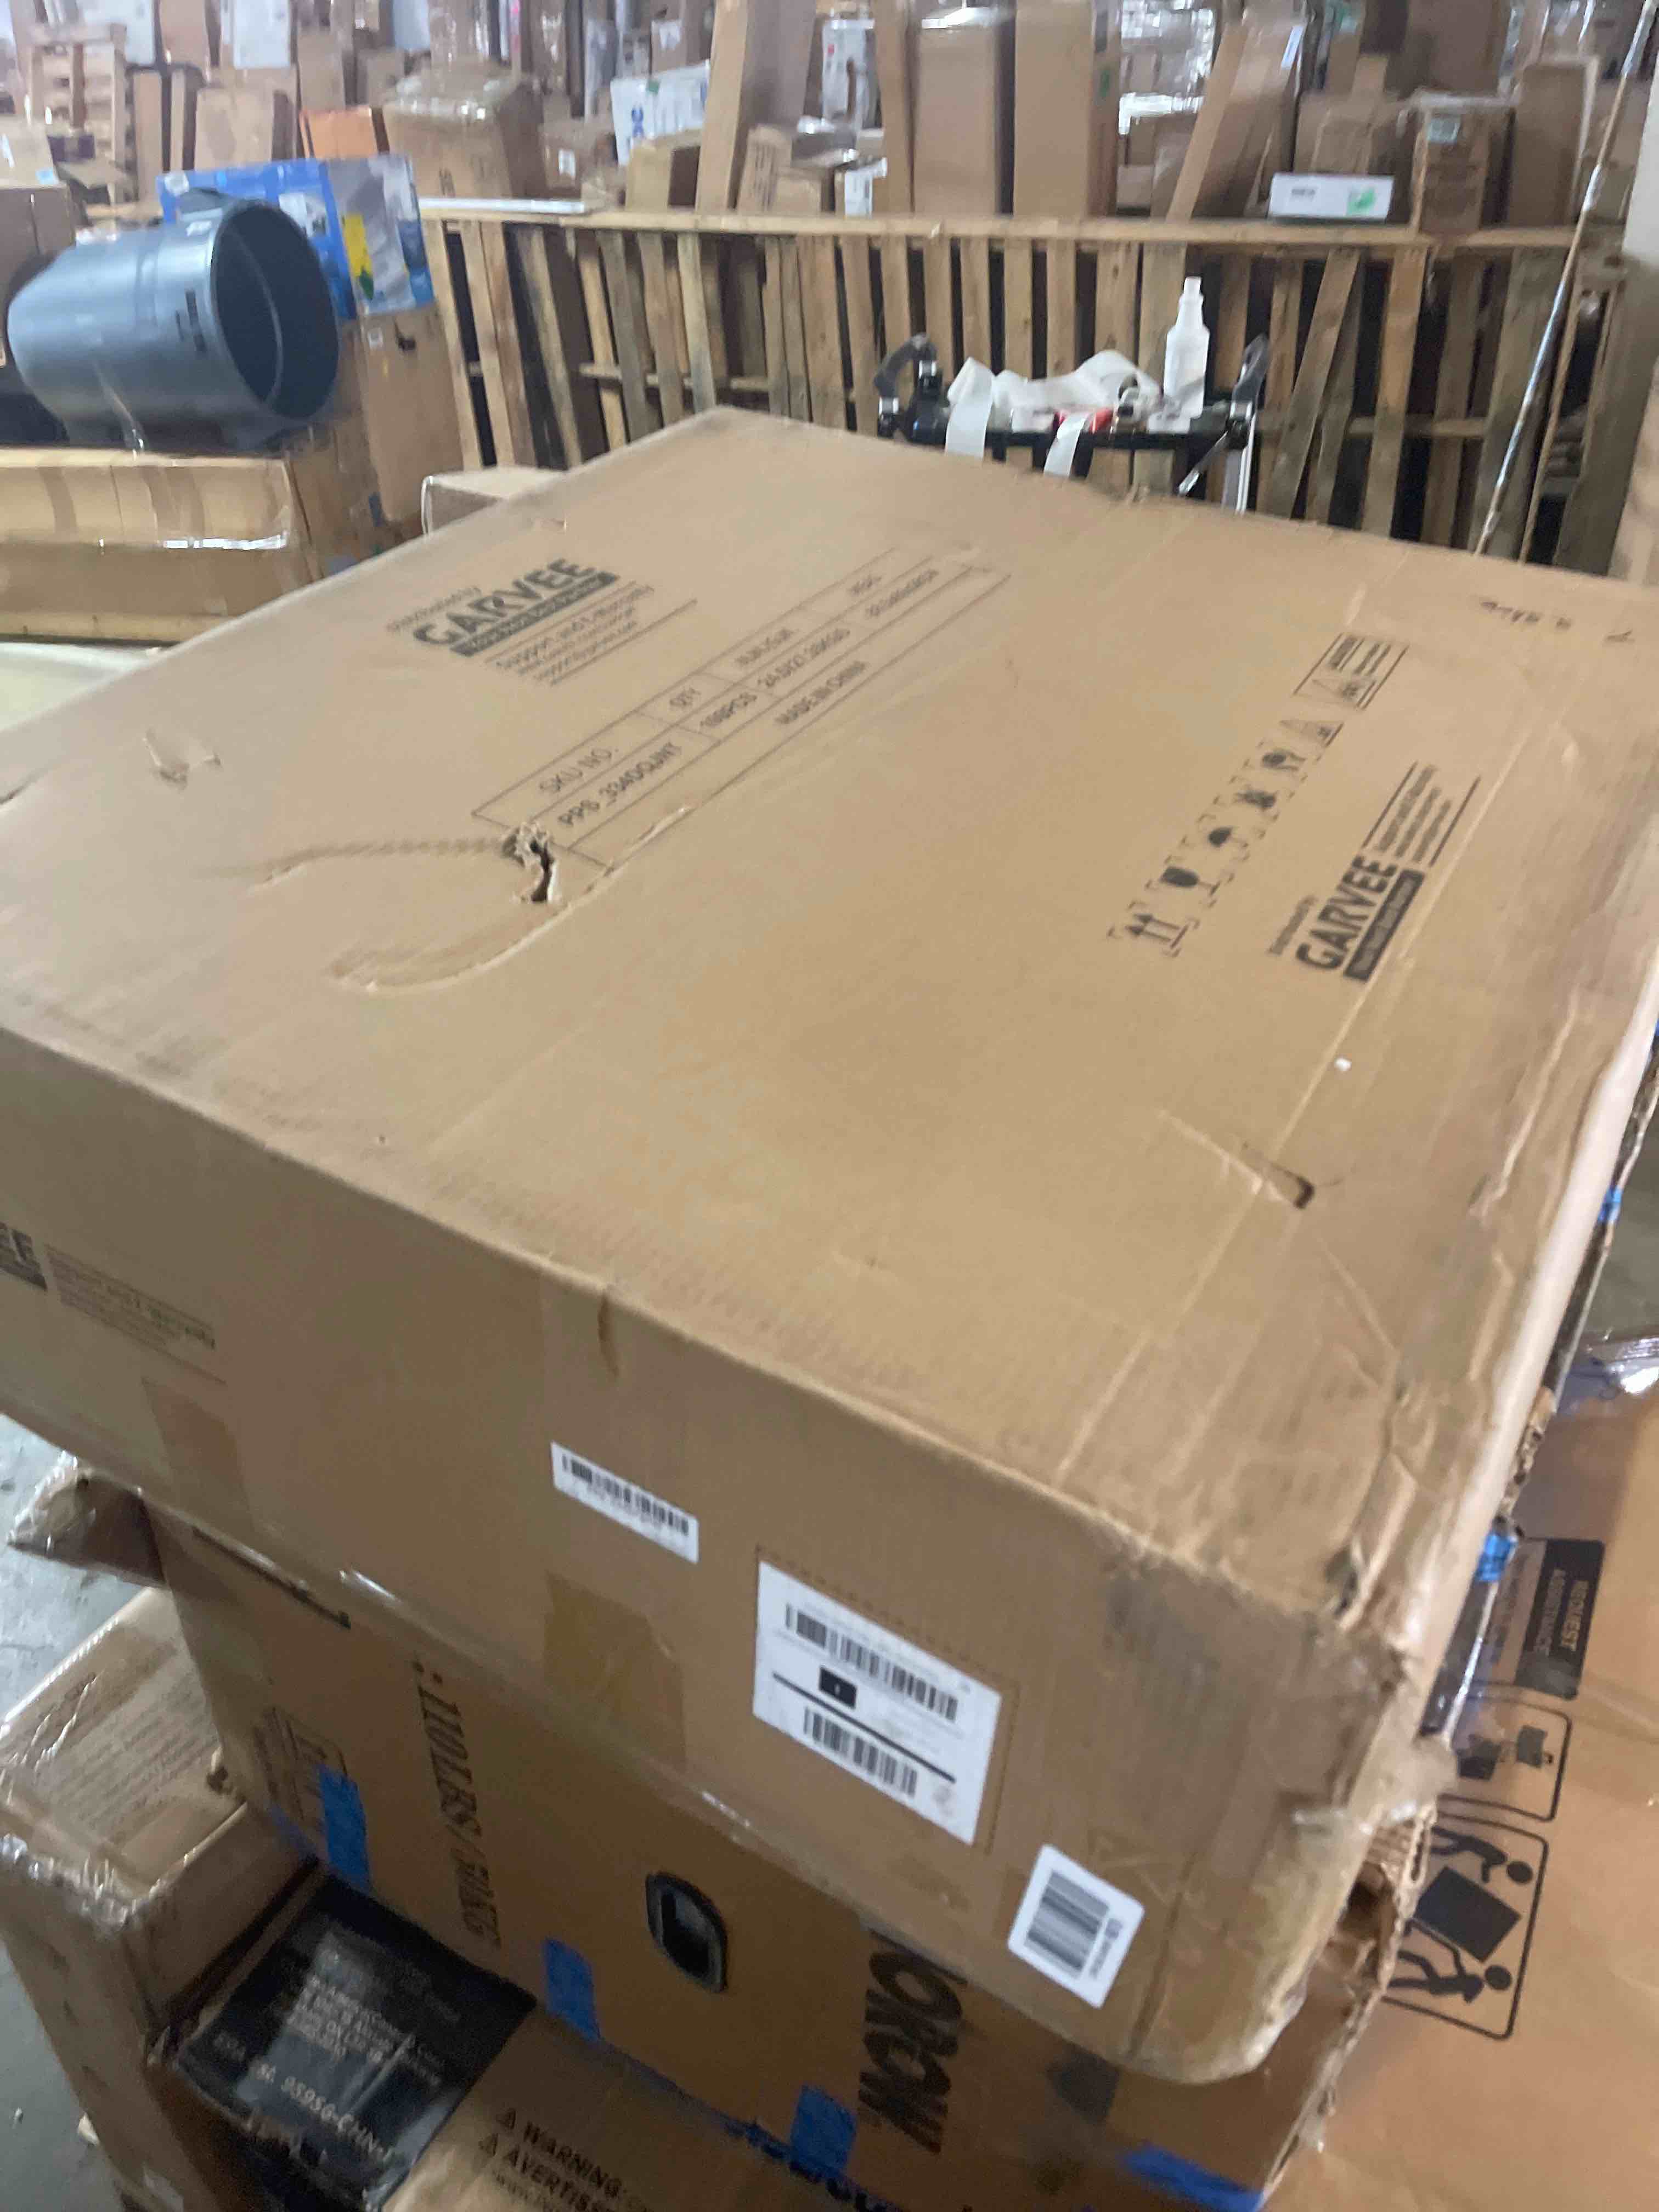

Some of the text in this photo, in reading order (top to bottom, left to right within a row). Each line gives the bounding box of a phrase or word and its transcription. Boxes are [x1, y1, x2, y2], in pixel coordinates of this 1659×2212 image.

[413, 557, 596, 646] GARVEE
[538, 766, 584, 793] SKU
[1294, 855, 1398, 971] GARVEE
[1560, 1580, 1590, 1652] REQUEST
